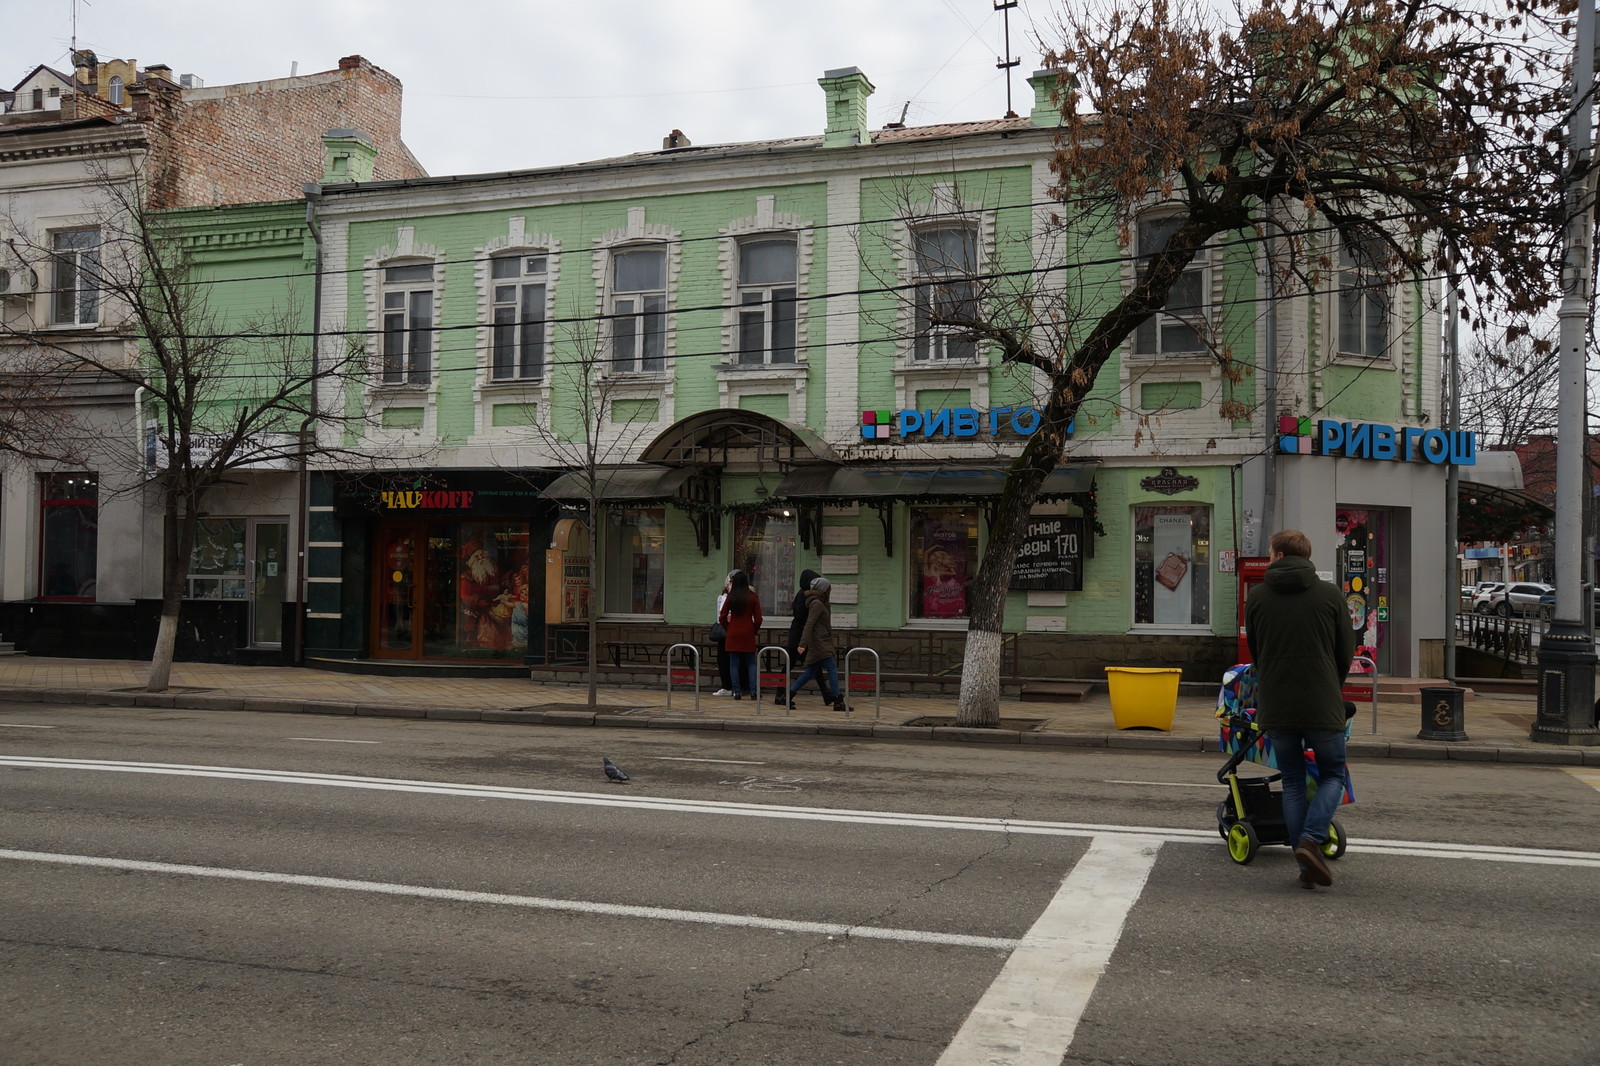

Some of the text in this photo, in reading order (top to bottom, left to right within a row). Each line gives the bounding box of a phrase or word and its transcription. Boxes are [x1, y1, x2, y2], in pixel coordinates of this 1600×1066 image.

[899, 406, 1075, 438] РИВ ГО
[1318, 420, 1476, 465] РИВ ГОШ
[1024, 520, 1061, 539] тные
[1054, 533, 1078, 556] 170
